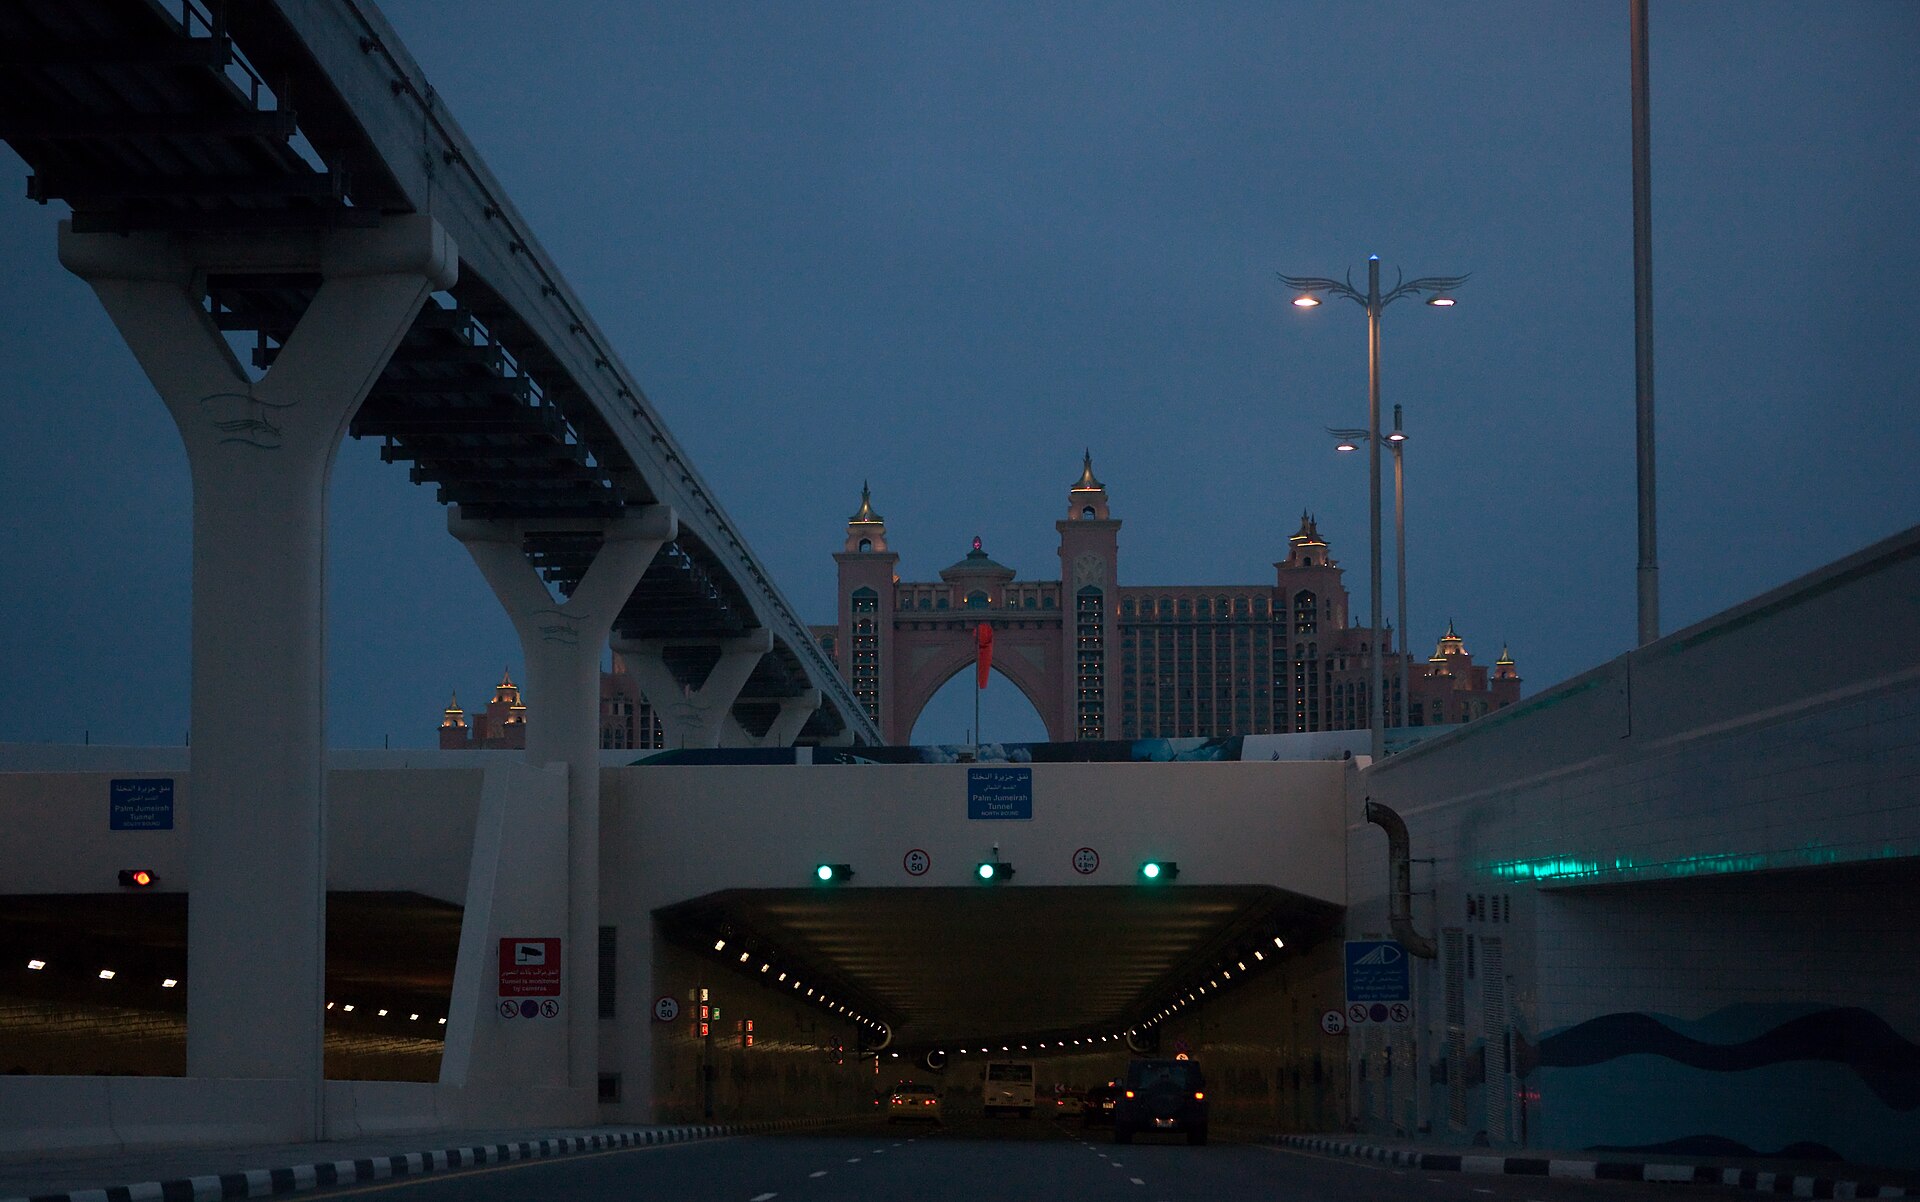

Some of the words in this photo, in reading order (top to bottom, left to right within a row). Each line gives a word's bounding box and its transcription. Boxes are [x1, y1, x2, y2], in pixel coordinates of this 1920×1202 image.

[994, 773, 1014, 782] جزيرة
[130, 813, 155, 821] Tunnel
[911, 863, 923, 871] 50
[1328, 1024, 1339, 1032] 50
